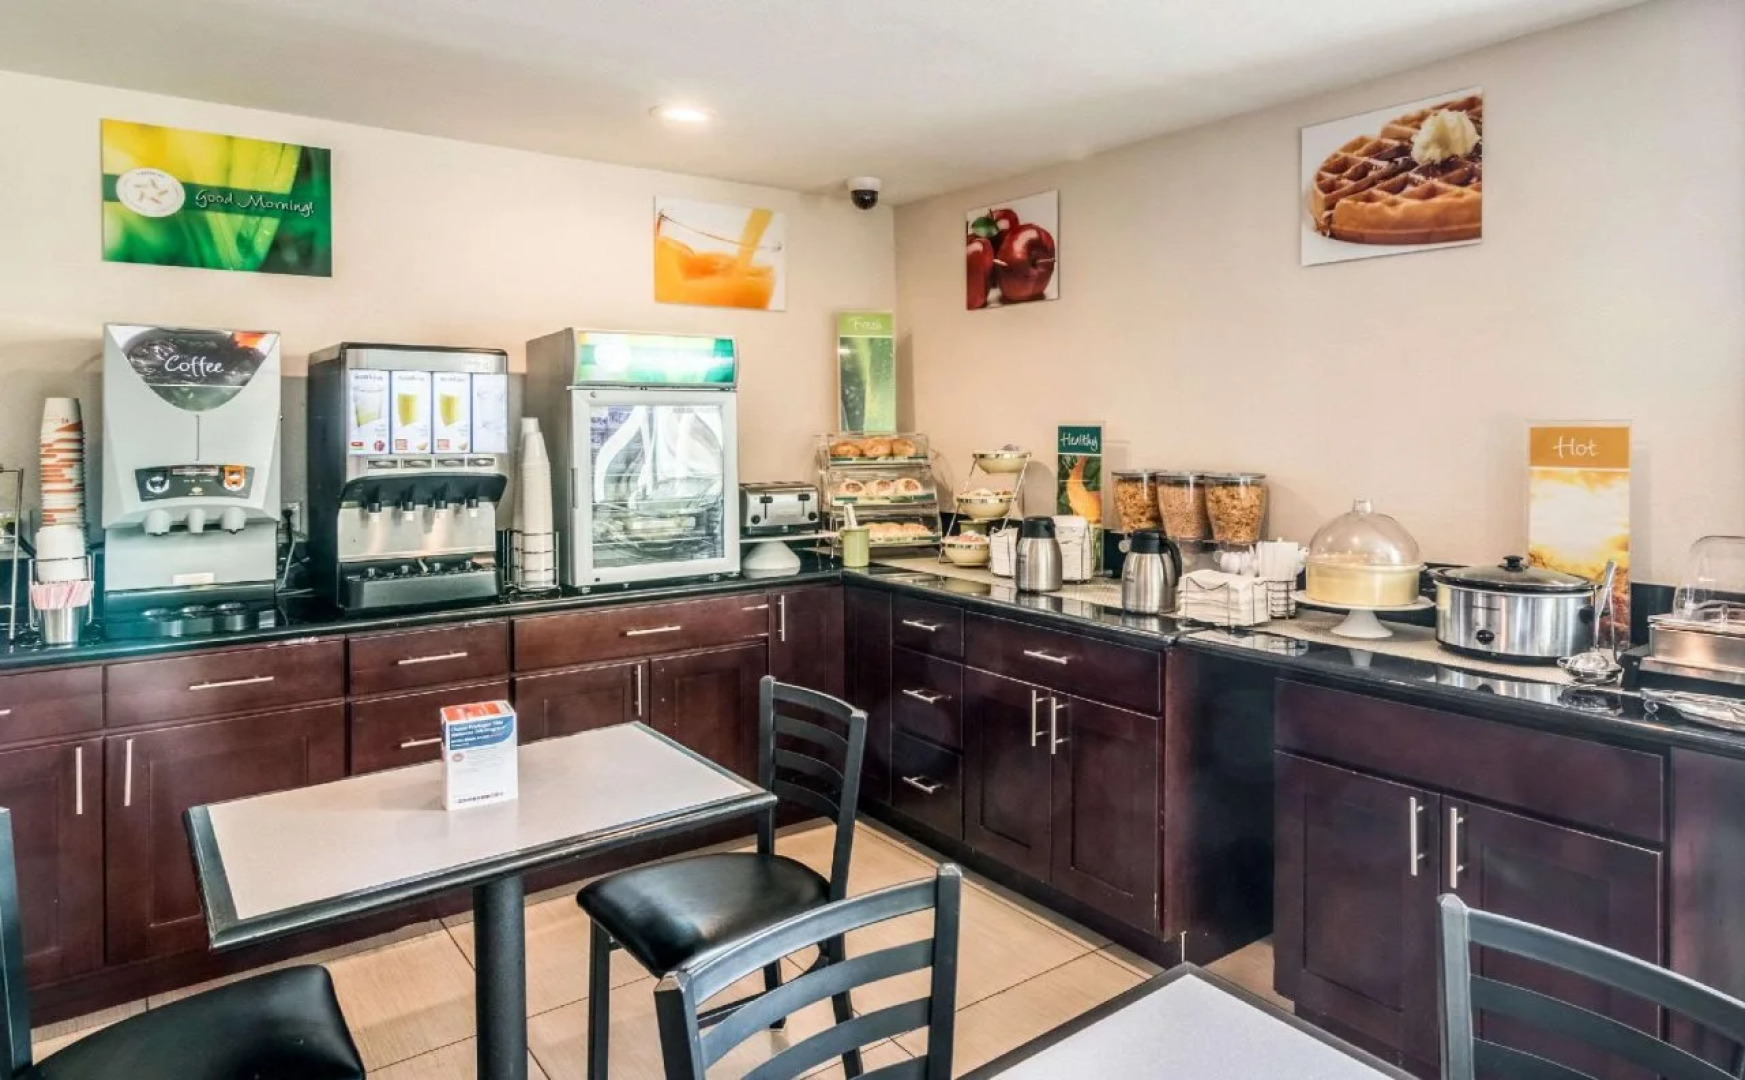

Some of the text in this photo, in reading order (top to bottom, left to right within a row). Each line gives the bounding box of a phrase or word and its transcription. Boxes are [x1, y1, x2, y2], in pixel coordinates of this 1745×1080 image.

[195, 189, 315, 218] Good Morning!
[849, 316, 882, 330] Fresh
[164, 355, 225, 377] Coffee
[1060, 432, 1098, 452] Healthy
[1553, 436, 1597, 459] Hot
